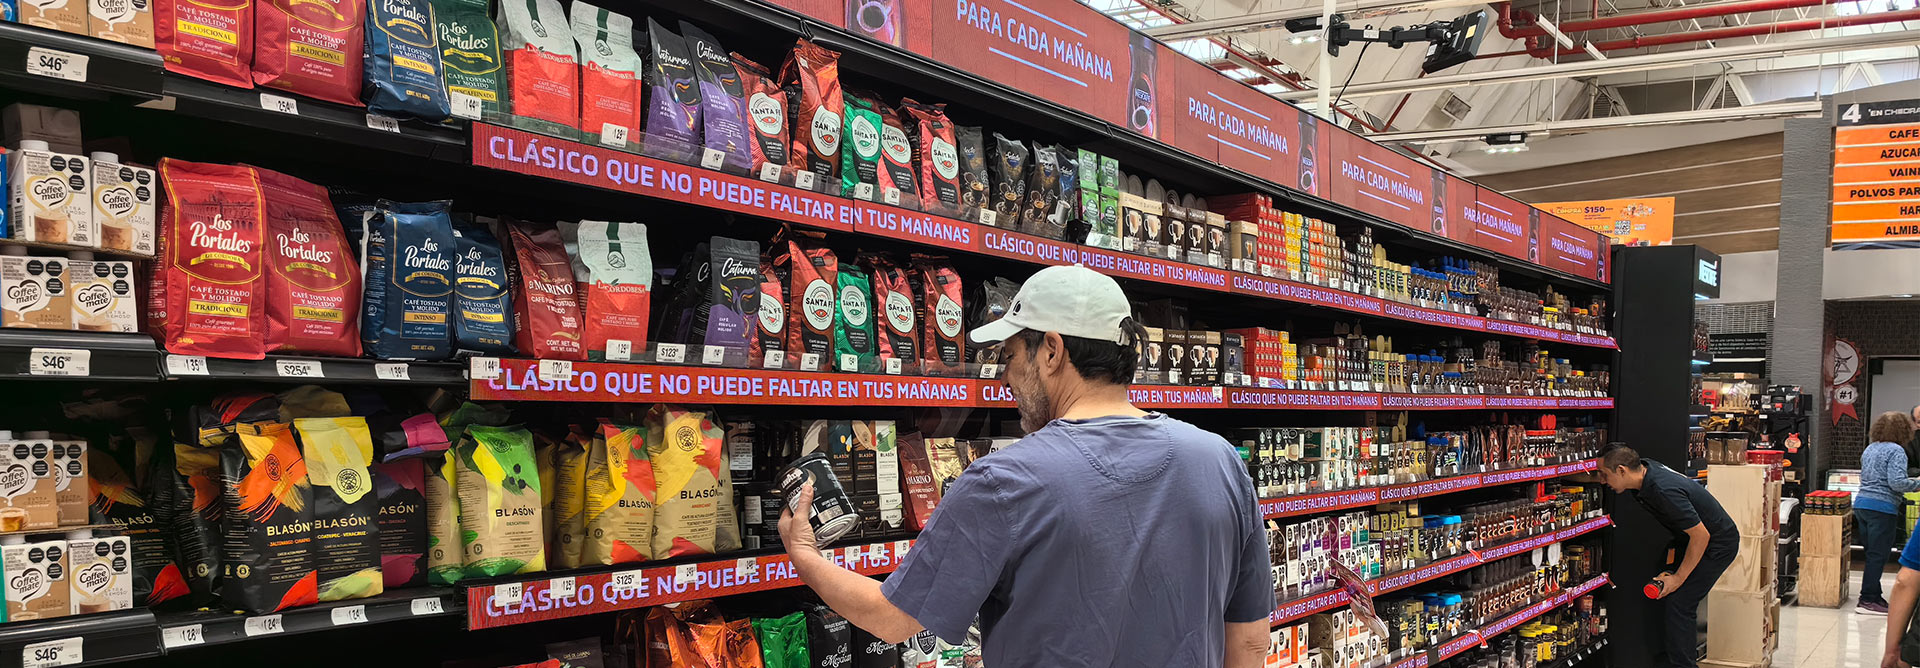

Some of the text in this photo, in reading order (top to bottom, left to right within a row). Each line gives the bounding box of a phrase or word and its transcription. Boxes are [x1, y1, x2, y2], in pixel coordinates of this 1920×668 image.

[177, 4, 236, 24] CAFÉ TOSTADO
[194, 14, 227, 29] MOLIDO
[450, 22, 467, 35] Los
[183, 23, 231, 41] TRADICIONAL
[290, 27, 346, 45] CAFÉ TOSTADO
[438, 23, 488, 49] Portales
[306, 36, 339, 50] MOLIDO
[957, 0, 1114, 82] PARA CADA MAÑANA
[295, 45, 340, 61] TRADICIONAL
[408, 46, 433, 60] TOSTADO
[696, 40, 731, 64] Caturra
[39, 55, 62, 71] $46
[403, 60, 427, 70] INTENSO
[465, 75, 495, 84] TOSTADO
[1842, 104, 1862, 123] 4
[1189, 97, 1289, 155] PARA CADA MAÑANA
[1889, 129, 1919, 139] CAFE
[34, 184, 63, 195] Coffee
[1342, 160, 1424, 205] PARA CADA MAÑANA
[41, 188, 65, 201] mate
[490, 135, 970, 245] CLÁSICO QUE NO PUEDE FALTAR EN TUS MAÑANAS
[1850, 187, 1895, 199] POLVOS
[102, 194, 130, 204] Coffee
[109, 200, 131, 210] mate
[1584, 206, 1605, 214] $150
[209, 214, 232, 232] Los
[1464, 206, 1523, 238] PARA CADA MAÑANA
[190, 221, 251, 253] Portales
[290, 227, 309, 244] Los
[277, 233, 331, 264] Portales
[420, 237, 438, 253] Los
[1551, 237, 1593, 260] PARA CADA MAÑANA
[404, 245, 449, 271] Portales
[465, 246, 482, 260] Los
[985, 232, 1226, 287] CLÁSICO QUE NO PUEDE FALTAR EN TUS MAÑANAS
[721, 257, 758, 278] Caturra
[8, 285, 38, 299] Coffee
[190, 285, 250, 297] CAFÉ TOSTADO
[534, 279, 573, 296] MARINO
[1233, 275, 1381, 312] CLÁSICO QUE NO PUEDE FALTAR EN TUS MAÑANAS
[16, 293, 38, 305] mate
[78, 292, 107, 302] Coffee
[85, 297, 109, 308] mate
[209, 294, 242, 303] MOLIDO
[291, 290, 342, 303] CAFÉ TOSTADO
[307, 299, 335, 307] MOLIDO
[805, 297, 826, 307] SANTA
[195, 303, 243, 314] TRADICIONAL
[298, 308, 338, 319] TRADICIONAL
[660, 347, 676, 358] $123
[42, 355, 65, 369] $46
[284, 365, 307, 375] $254
[604, 372, 653, 396] QUE
[660, 374, 691, 395] NO
[697, 375, 763, 397] PUEDE
[769, 378, 833, 398] FALTAR
[837, 380, 859, 398] EN
[863, 381, 894, 399] TUS
[897, 380, 968, 401] MAÑANAS
[1151, 390, 1163, 403] EN
[1165, 390, 1182, 404] TUS
[1231, 390, 1379, 406] CLÁSICO QUE NO PUEDE FALTAR EN TUS MAÑANAS
[1839, 390, 1853, 400] #1
[4, 478, 26, 490] mate
[619, 498, 652, 509] BLASÓN
[1260, 490, 1376, 516] QUE NO PUEDE FALTAR EN TUS MAÑANAS
[495, 507, 534, 518] BLASÓN
[267, 519, 311, 537] BLASÓN
[314, 513, 367, 530] BLASÓN
[10, 574, 39, 590] Coffee
[79, 570, 107, 584] Coffee
[86, 577, 108, 588] mate
[616, 574, 633, 586] $125
[19, 582, 40, 594] mate
[1274, 594, 1337, 620] NO PUEDE FALTAR EN
[35, 646, 57, 661] $46
